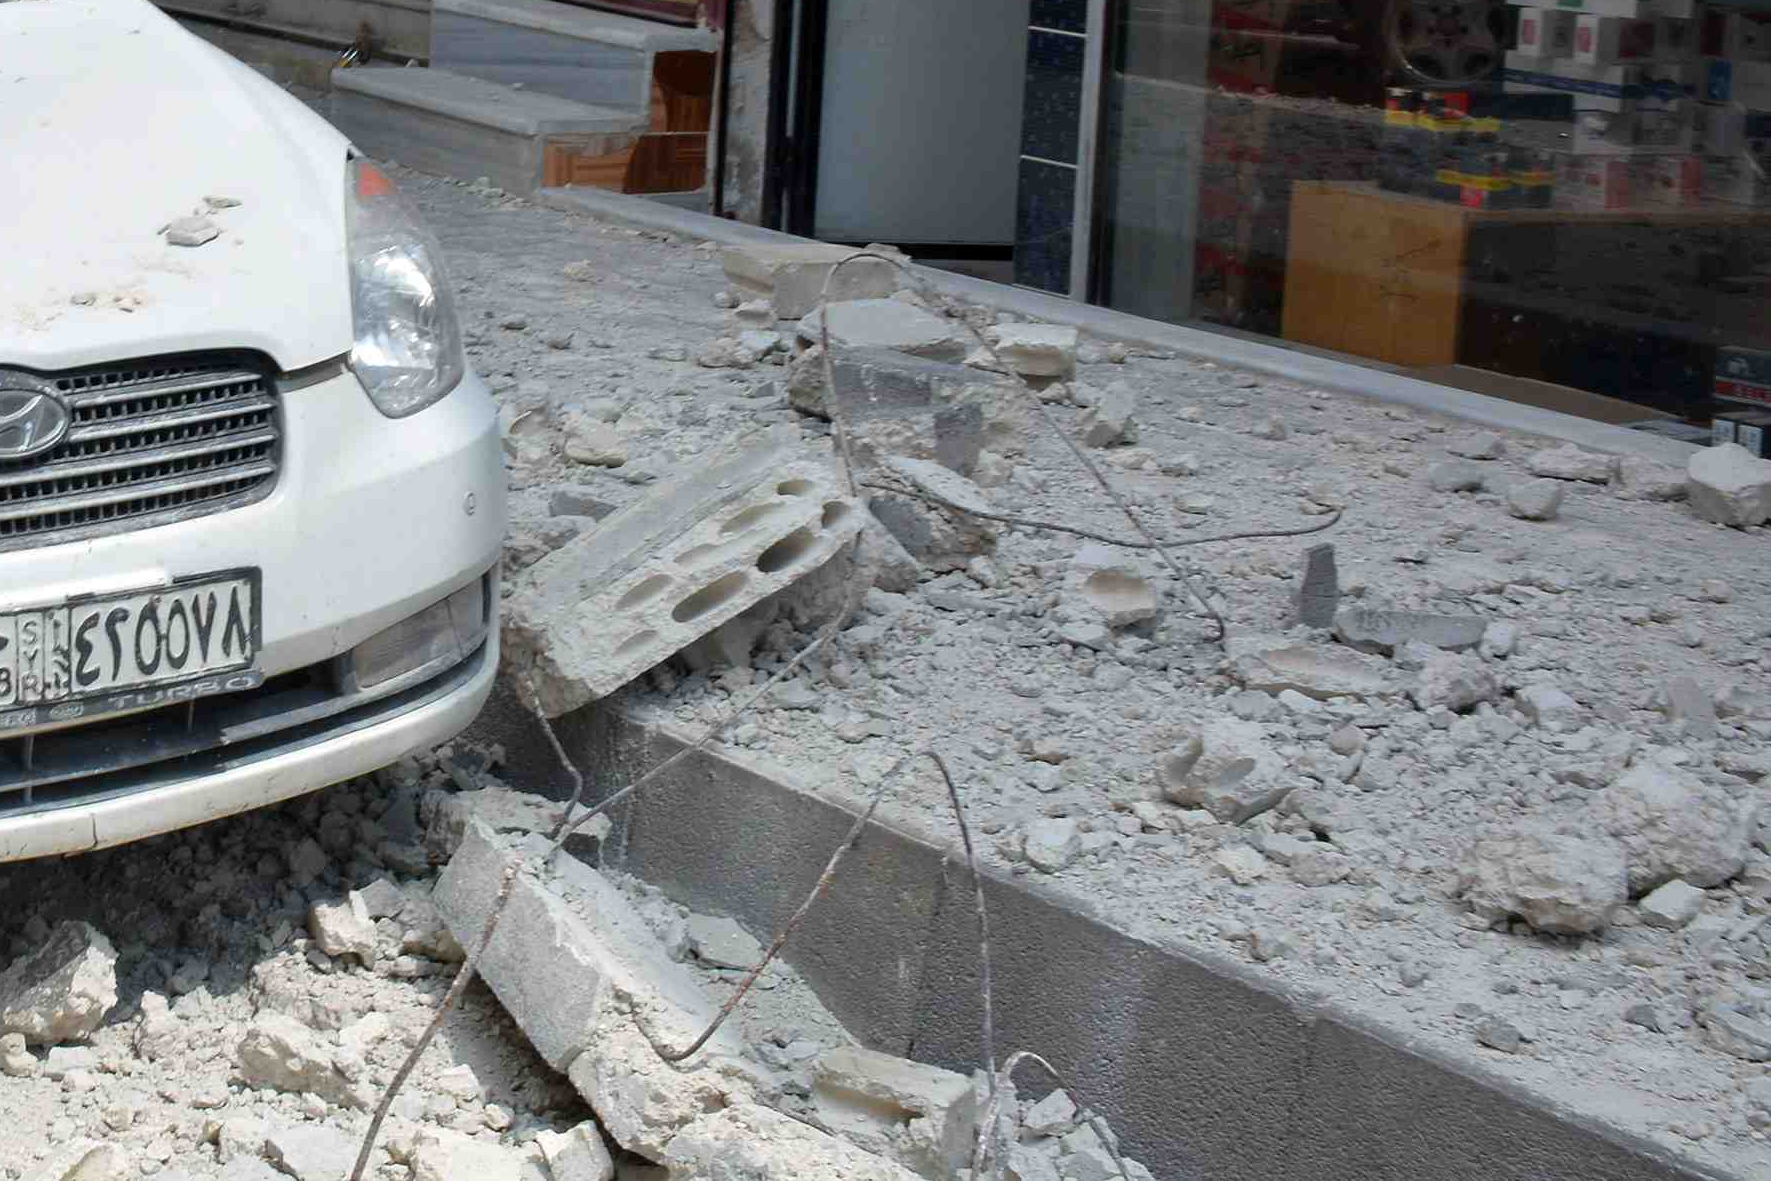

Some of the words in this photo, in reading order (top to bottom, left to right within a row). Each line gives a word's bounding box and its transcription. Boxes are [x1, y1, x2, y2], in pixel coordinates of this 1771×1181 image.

[21, 620, 42, 698] SYR
[74, 582, 254, 687] ٤٢٥٥٧٨
[107, 674, 256, 710] TURBO
